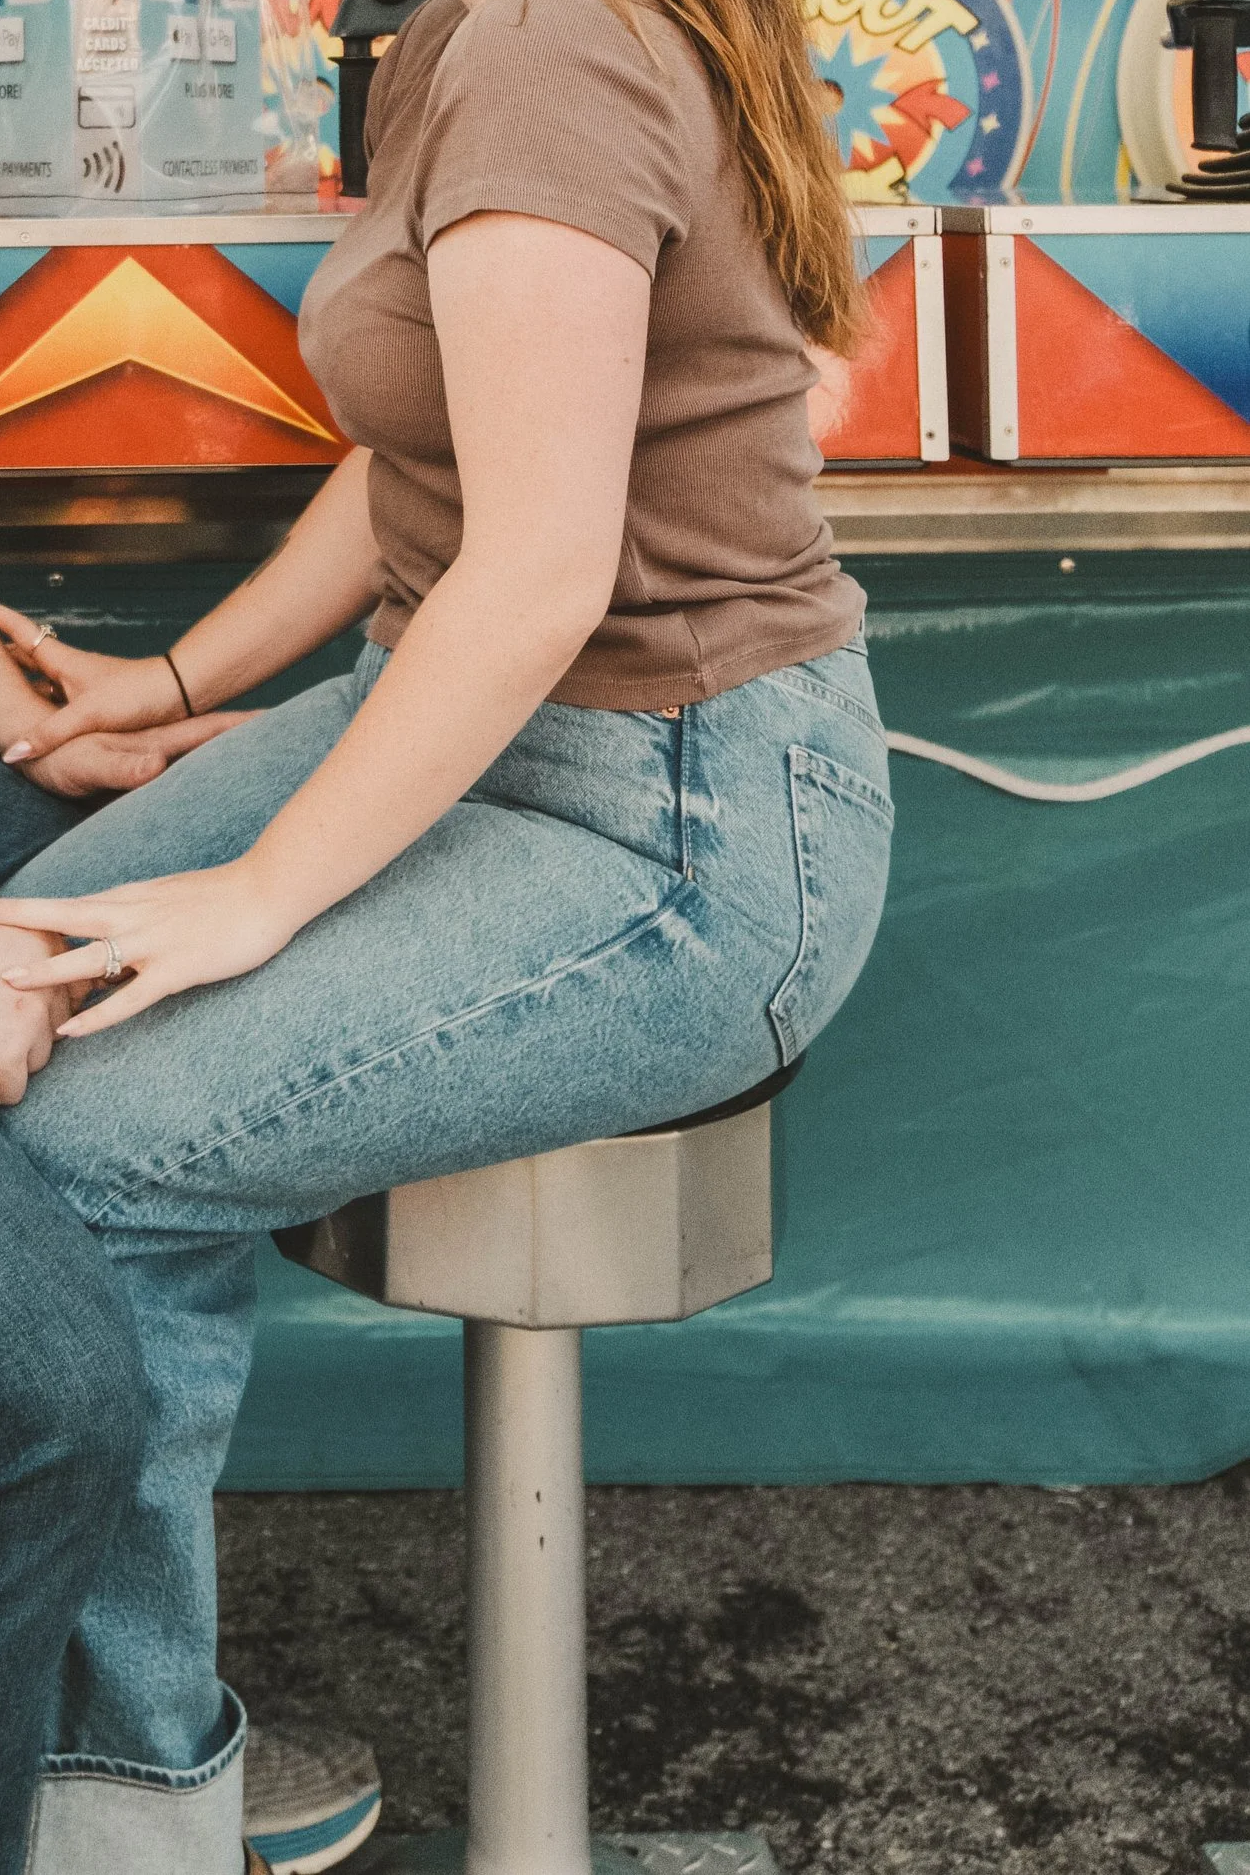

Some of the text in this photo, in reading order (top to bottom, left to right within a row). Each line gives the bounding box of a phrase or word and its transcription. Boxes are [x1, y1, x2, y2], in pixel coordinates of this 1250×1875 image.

[85, 37, 128, 53] CARDS
[1, 161, 52, 178] PAYMENTS
[162, 158, 259, 177] CONTACTLESS PAYMENTS
